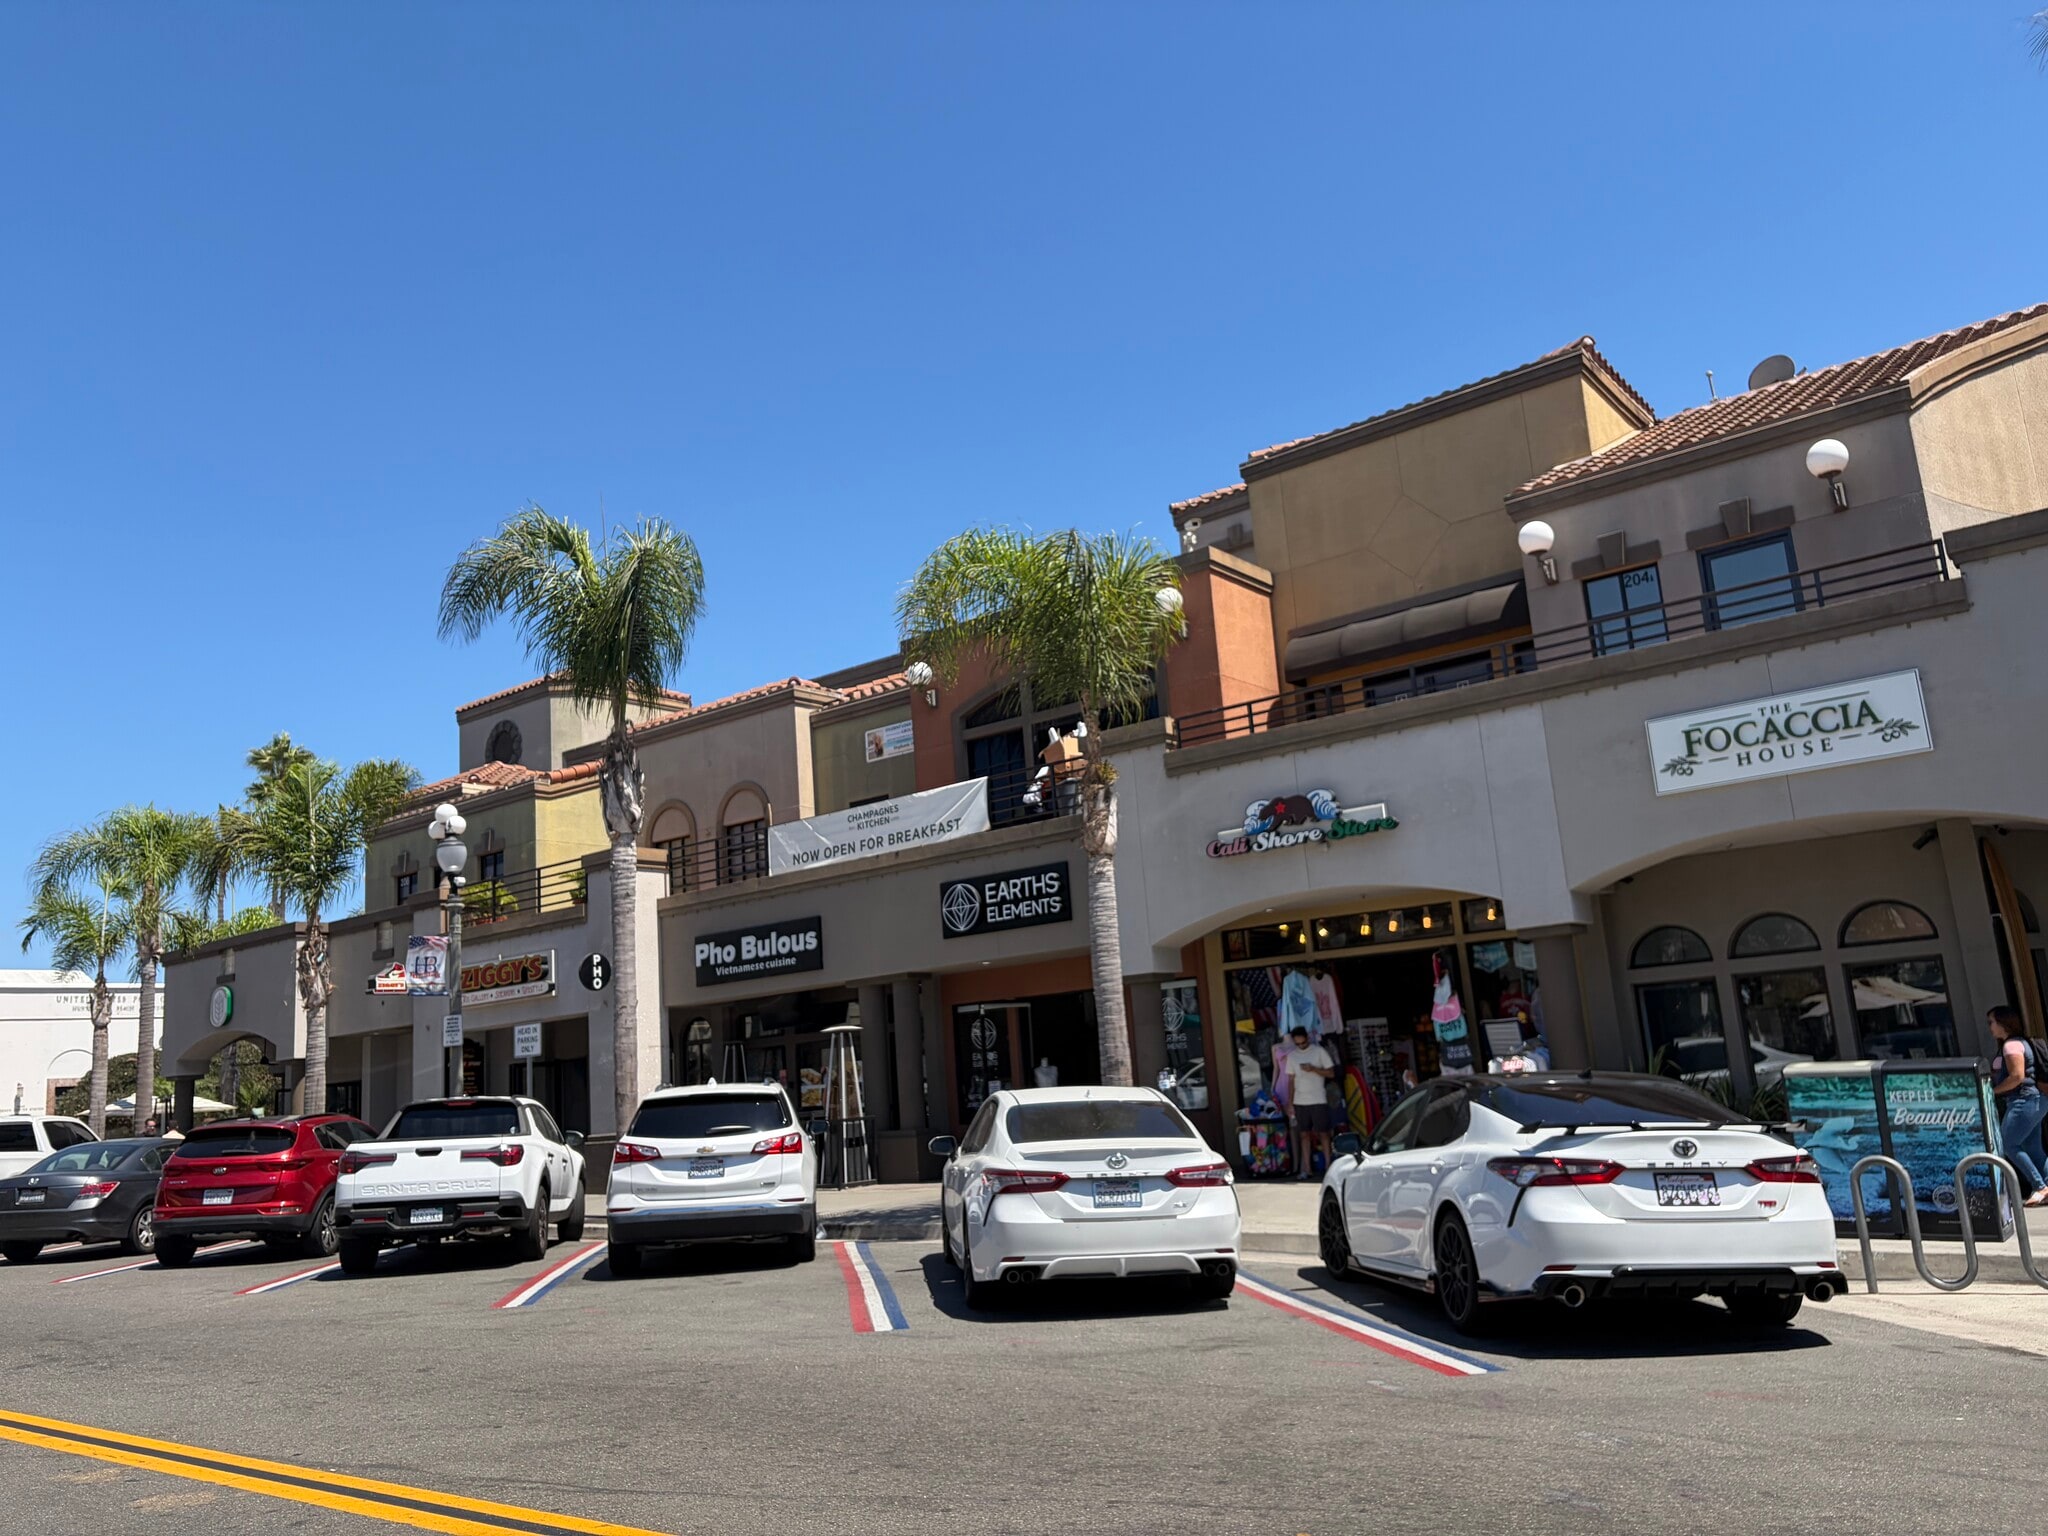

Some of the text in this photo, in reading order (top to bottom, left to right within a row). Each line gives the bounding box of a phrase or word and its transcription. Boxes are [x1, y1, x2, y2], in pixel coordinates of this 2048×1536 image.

[1758, 702, 1792, 717] THE
[1681, 699, 1882, 758] FOCACCIA
[1737, 737, 1834, 767] HOUSE
[847, 804, 900, 823] CHAMPAGNES
[857, 816, 890, 831] KITCHEN
[792, 817, 962, 866] NOW OPEN FOR BREAKFAST
[1206, 816, 1400, 858] Cali Shore Store
[985, 872, 1061, 904] EARTHS
[986, 896, 1063, 923] ELEMENTS
[695, 930, 818, 968] Pho Bulous
[461, 955, 543, 990] ZIGGY'S
[593, 954, 602, 990] PHO
[715, 956, 797, 976] Vietnamese cuisine
[517, 1026, 538, 1035] HEAD IN
[517, 1036, 539, 1044] PARKING
[521, 1045, 534, 1053] ONLY
[1889, 1090, 1915, 1103] KEEP
[1894, 1107, 1976, 1131] Beautiful
[361, 1179, 491, 1196] SANTA CRUZ
